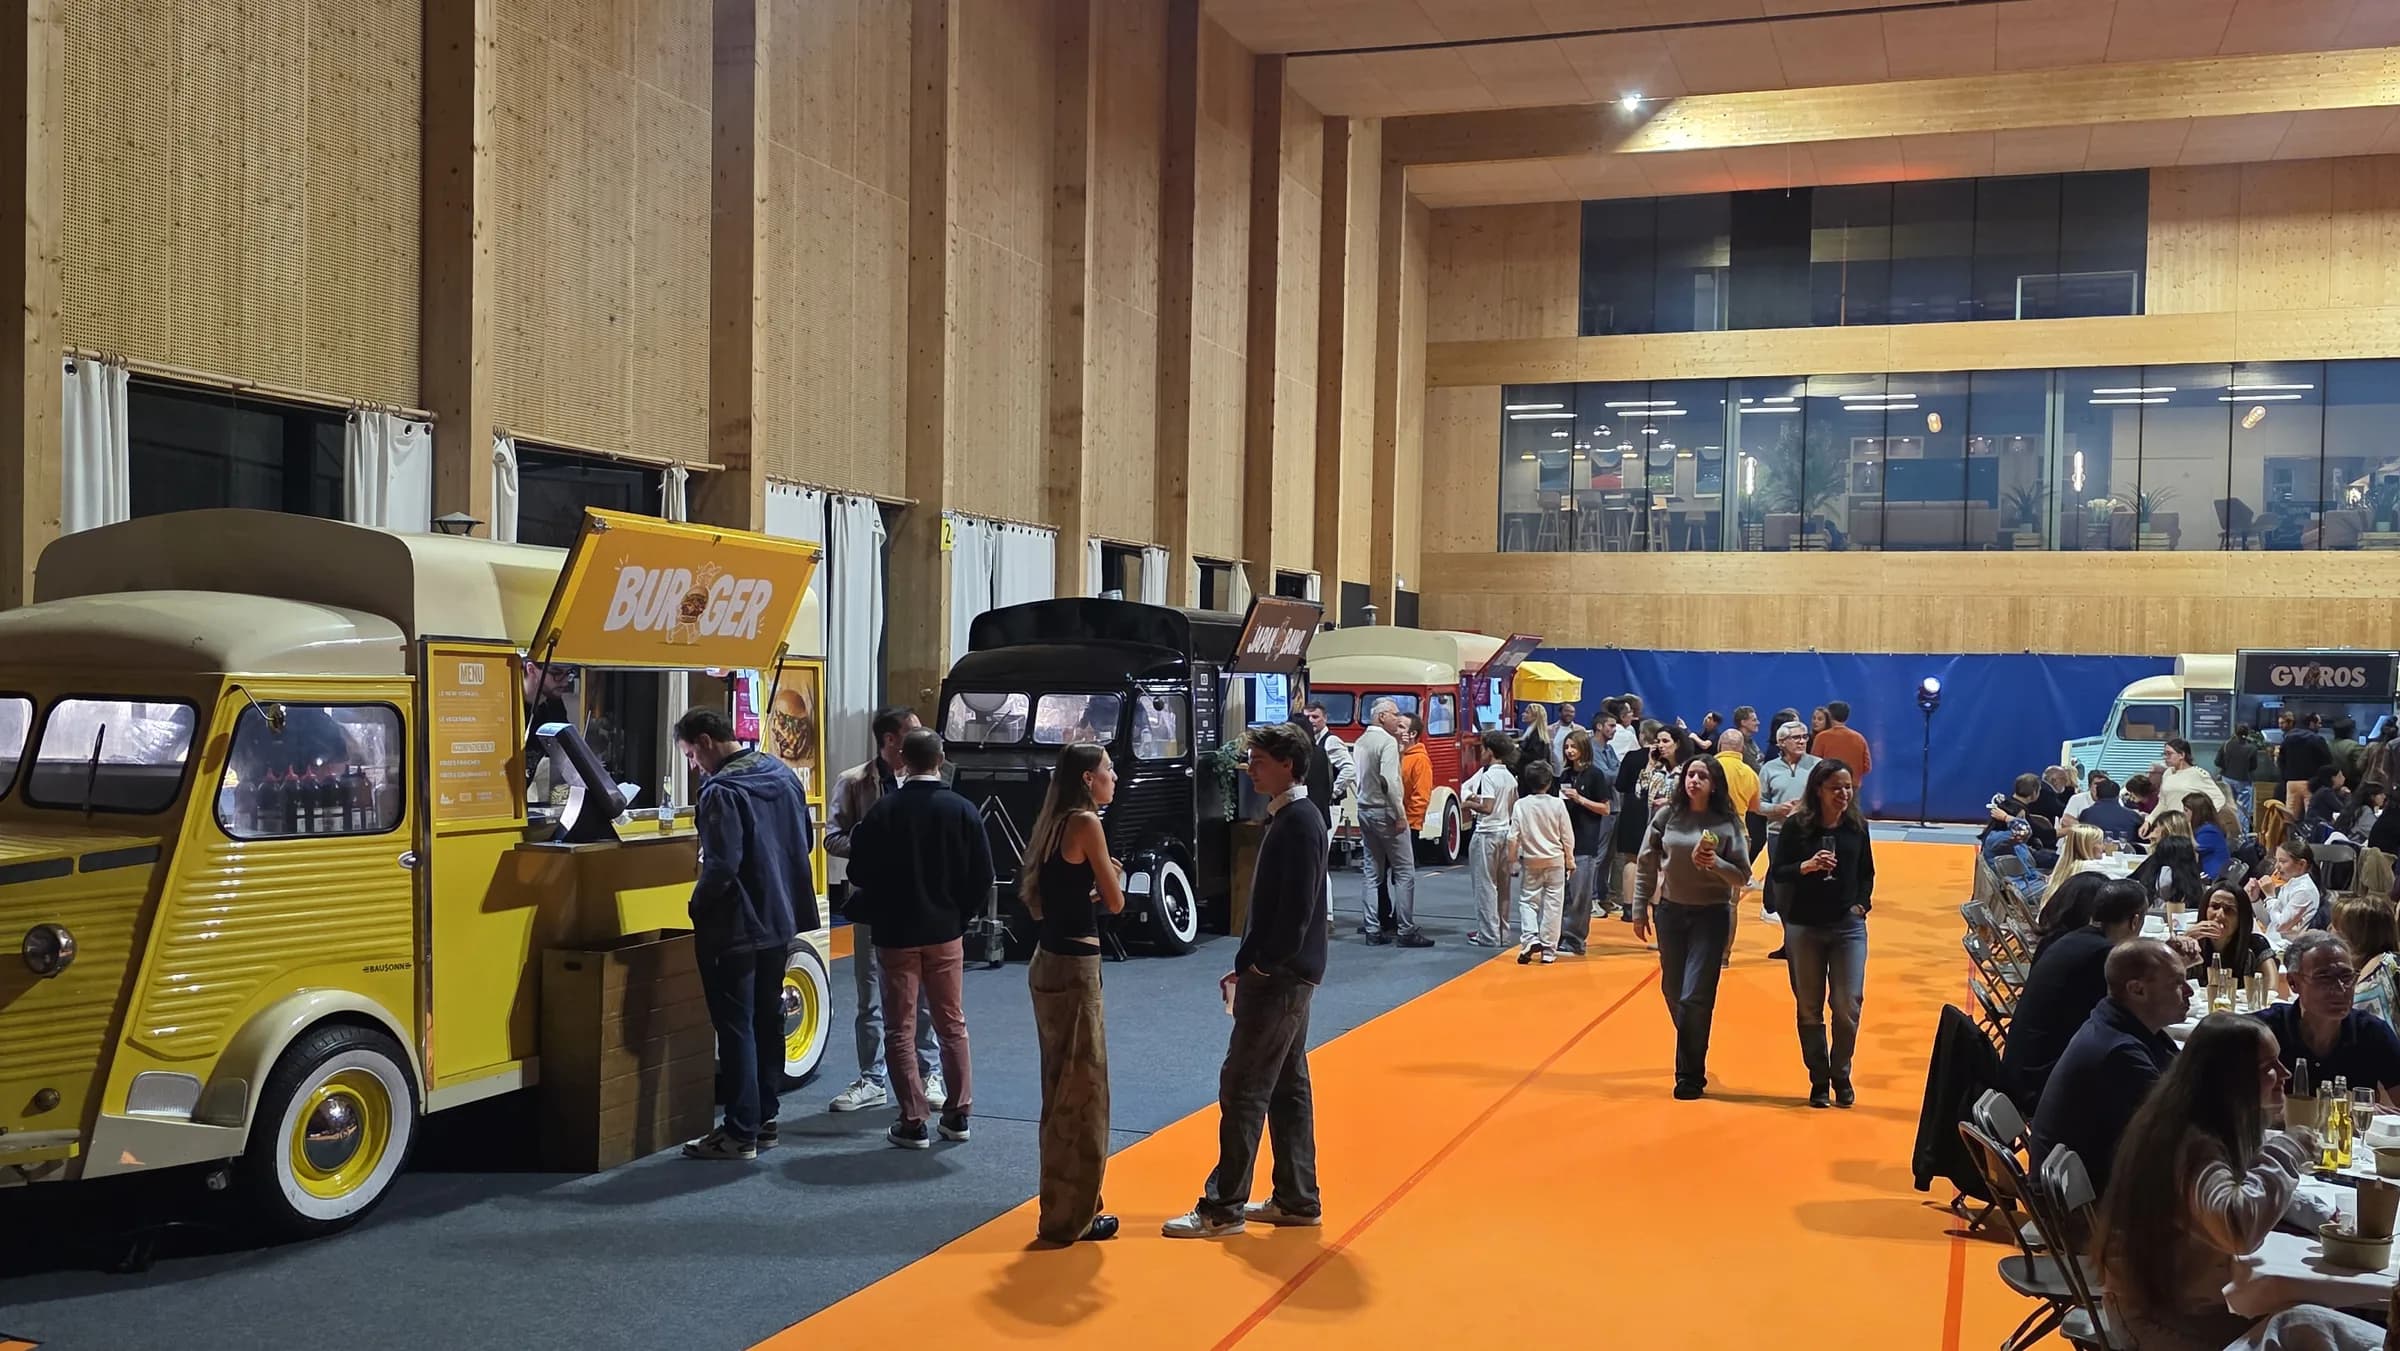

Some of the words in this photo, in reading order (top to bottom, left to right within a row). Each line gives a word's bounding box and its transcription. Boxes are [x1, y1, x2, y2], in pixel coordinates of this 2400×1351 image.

[945, 523, 951, 544] 2
[603, 565, 773, 640] BURGER
[1247, 625, 1280, 654] JAPAN
[460, 664, 483, 683] MENU
[2270, 666, 2366, 688] GYROS
